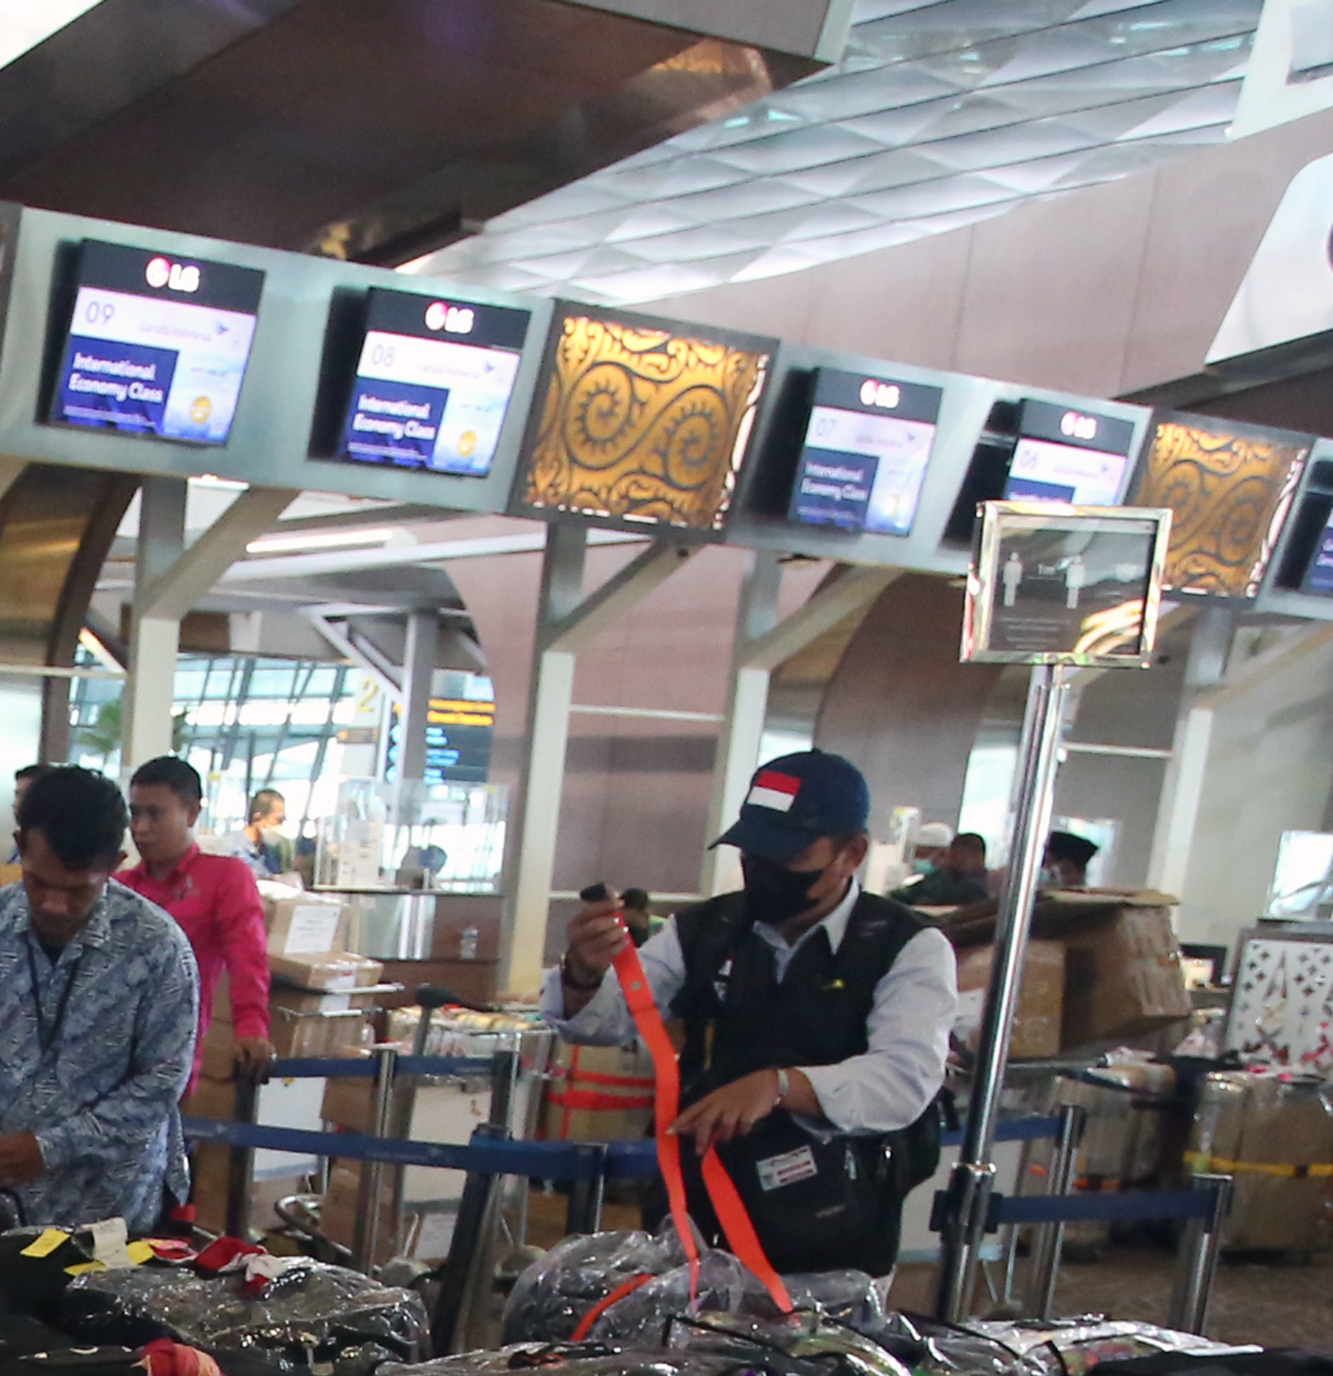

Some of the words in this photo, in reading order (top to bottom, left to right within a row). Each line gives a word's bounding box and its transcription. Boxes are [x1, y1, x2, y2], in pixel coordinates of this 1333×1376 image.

[167, 263, 201, 292] LG
[86, 301, 115, 325] 09
[358, 678, 380, 713] 2
